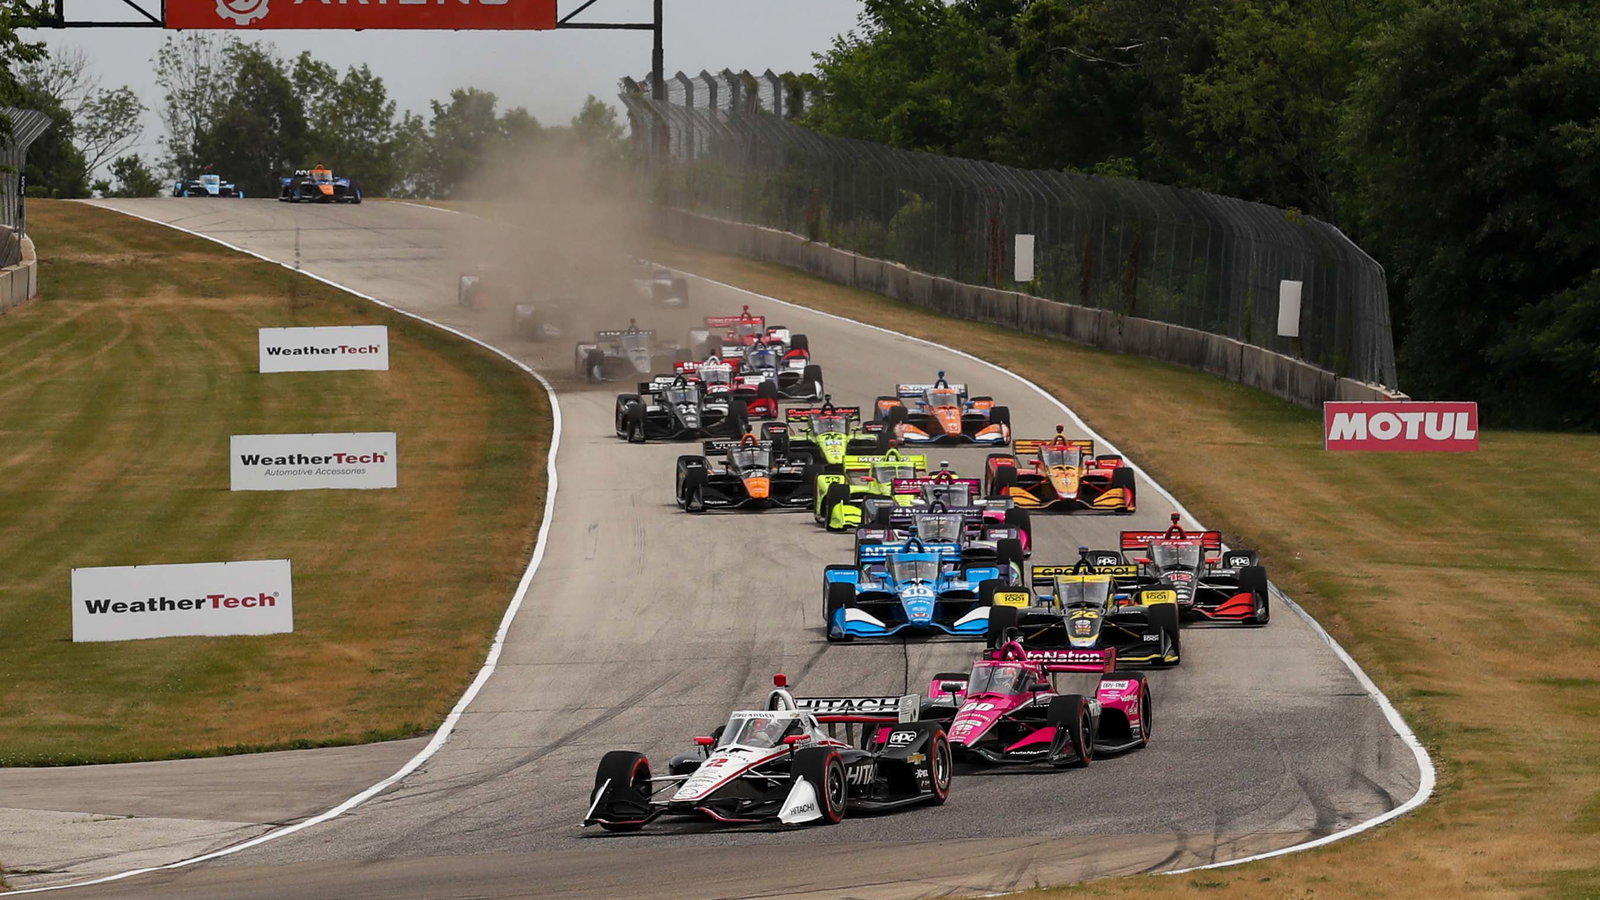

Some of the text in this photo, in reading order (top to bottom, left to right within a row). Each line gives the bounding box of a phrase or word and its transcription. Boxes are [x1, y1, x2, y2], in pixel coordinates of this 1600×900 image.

[1328, 412, 1476, 440] MOTUL
[264, 467, 366, 476] Automotive Accessories
[1230, 557, 1250, 566] PPG
[907, 588, 927, 596] 10
[1071, 610, 1099, 619] 26
[1007, 651, 1099, 662] toNation
[892, 733, 916, 743] PPG
[705, 758, 729, 768] 2
[789, 802, 815, 816] HITACHI
